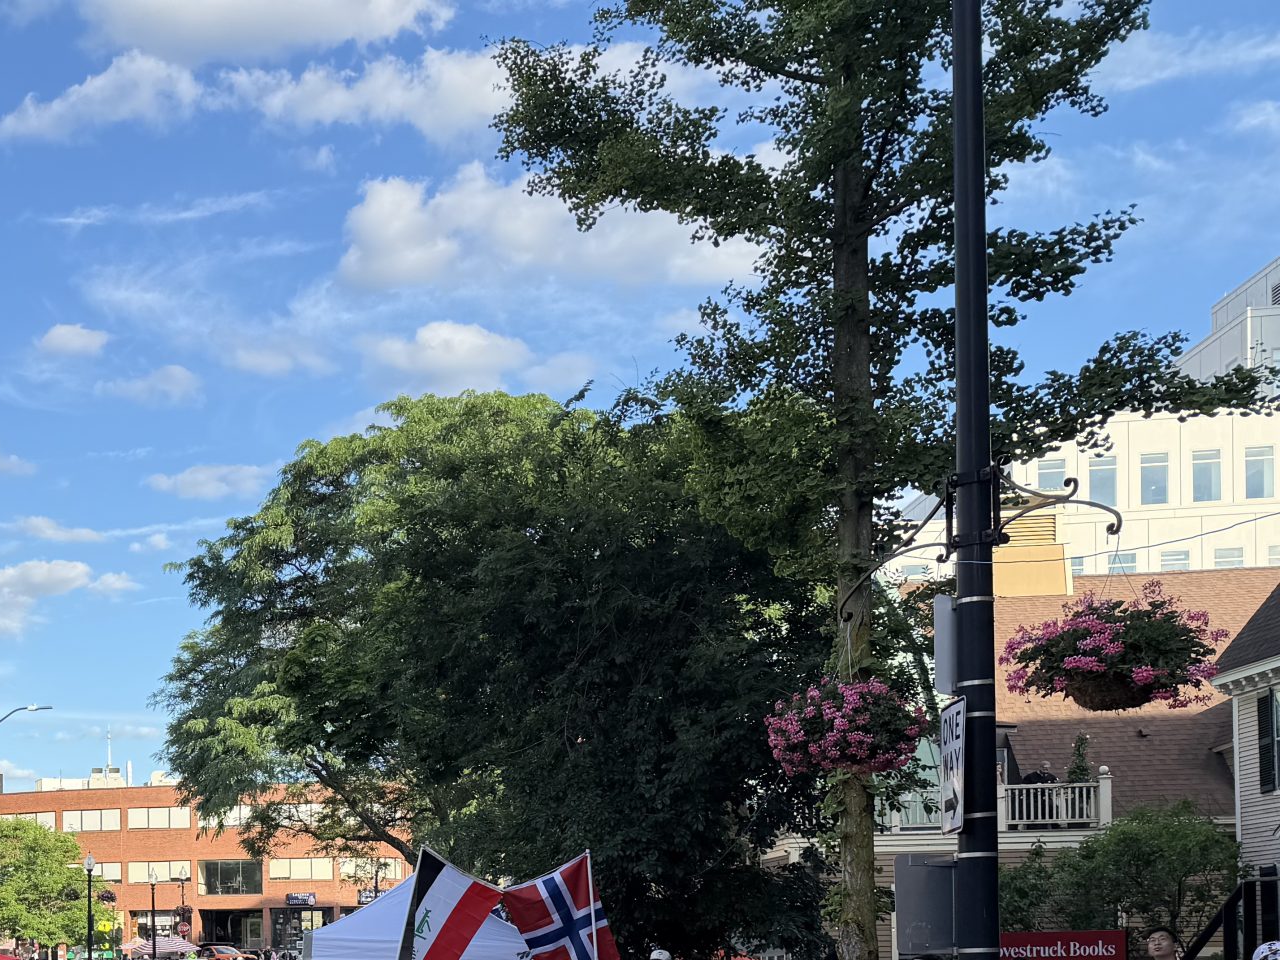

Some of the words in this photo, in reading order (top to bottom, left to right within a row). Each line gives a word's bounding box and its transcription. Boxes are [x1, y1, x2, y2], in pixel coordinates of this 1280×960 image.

[943, 710, 961, 746] ONE
[943, 747, 961, 782] WAY
[1000, 941, 1067, 958] ovestruck
[1069, 940, 1116, 957] Books
